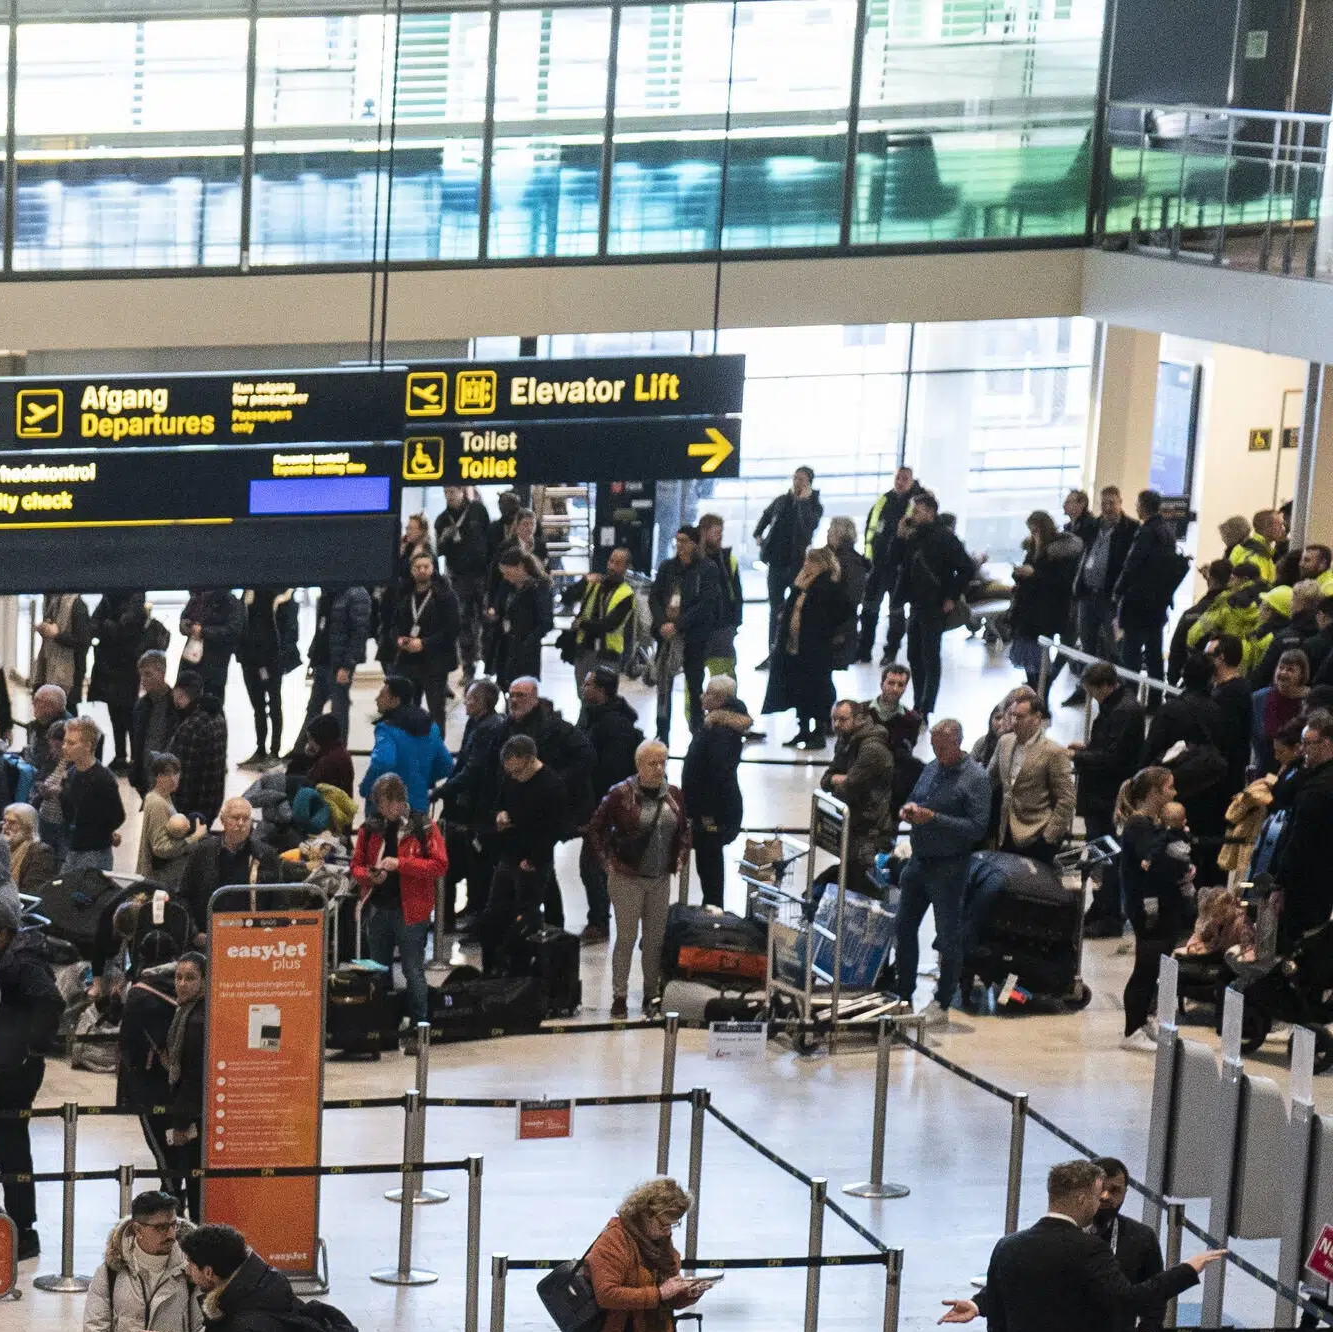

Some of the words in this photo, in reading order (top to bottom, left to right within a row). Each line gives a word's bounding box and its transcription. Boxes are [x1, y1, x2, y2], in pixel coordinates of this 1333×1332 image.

[81, 385, 168, 415] Afgang
[510, 377, 625, 406] Elevator
[634, 372, 680, 401] Lift
[81, 413, 215, 441] Departures
[460, 430, 518, 452] Toilet
[458, 456, 517, 478] Toilet
[21, 490, 73, 511] check
[226, 940, 308, 960] easyJet
[272, 957, 301, 971] plus
[269, 1251, 307, 1261] easyJet
